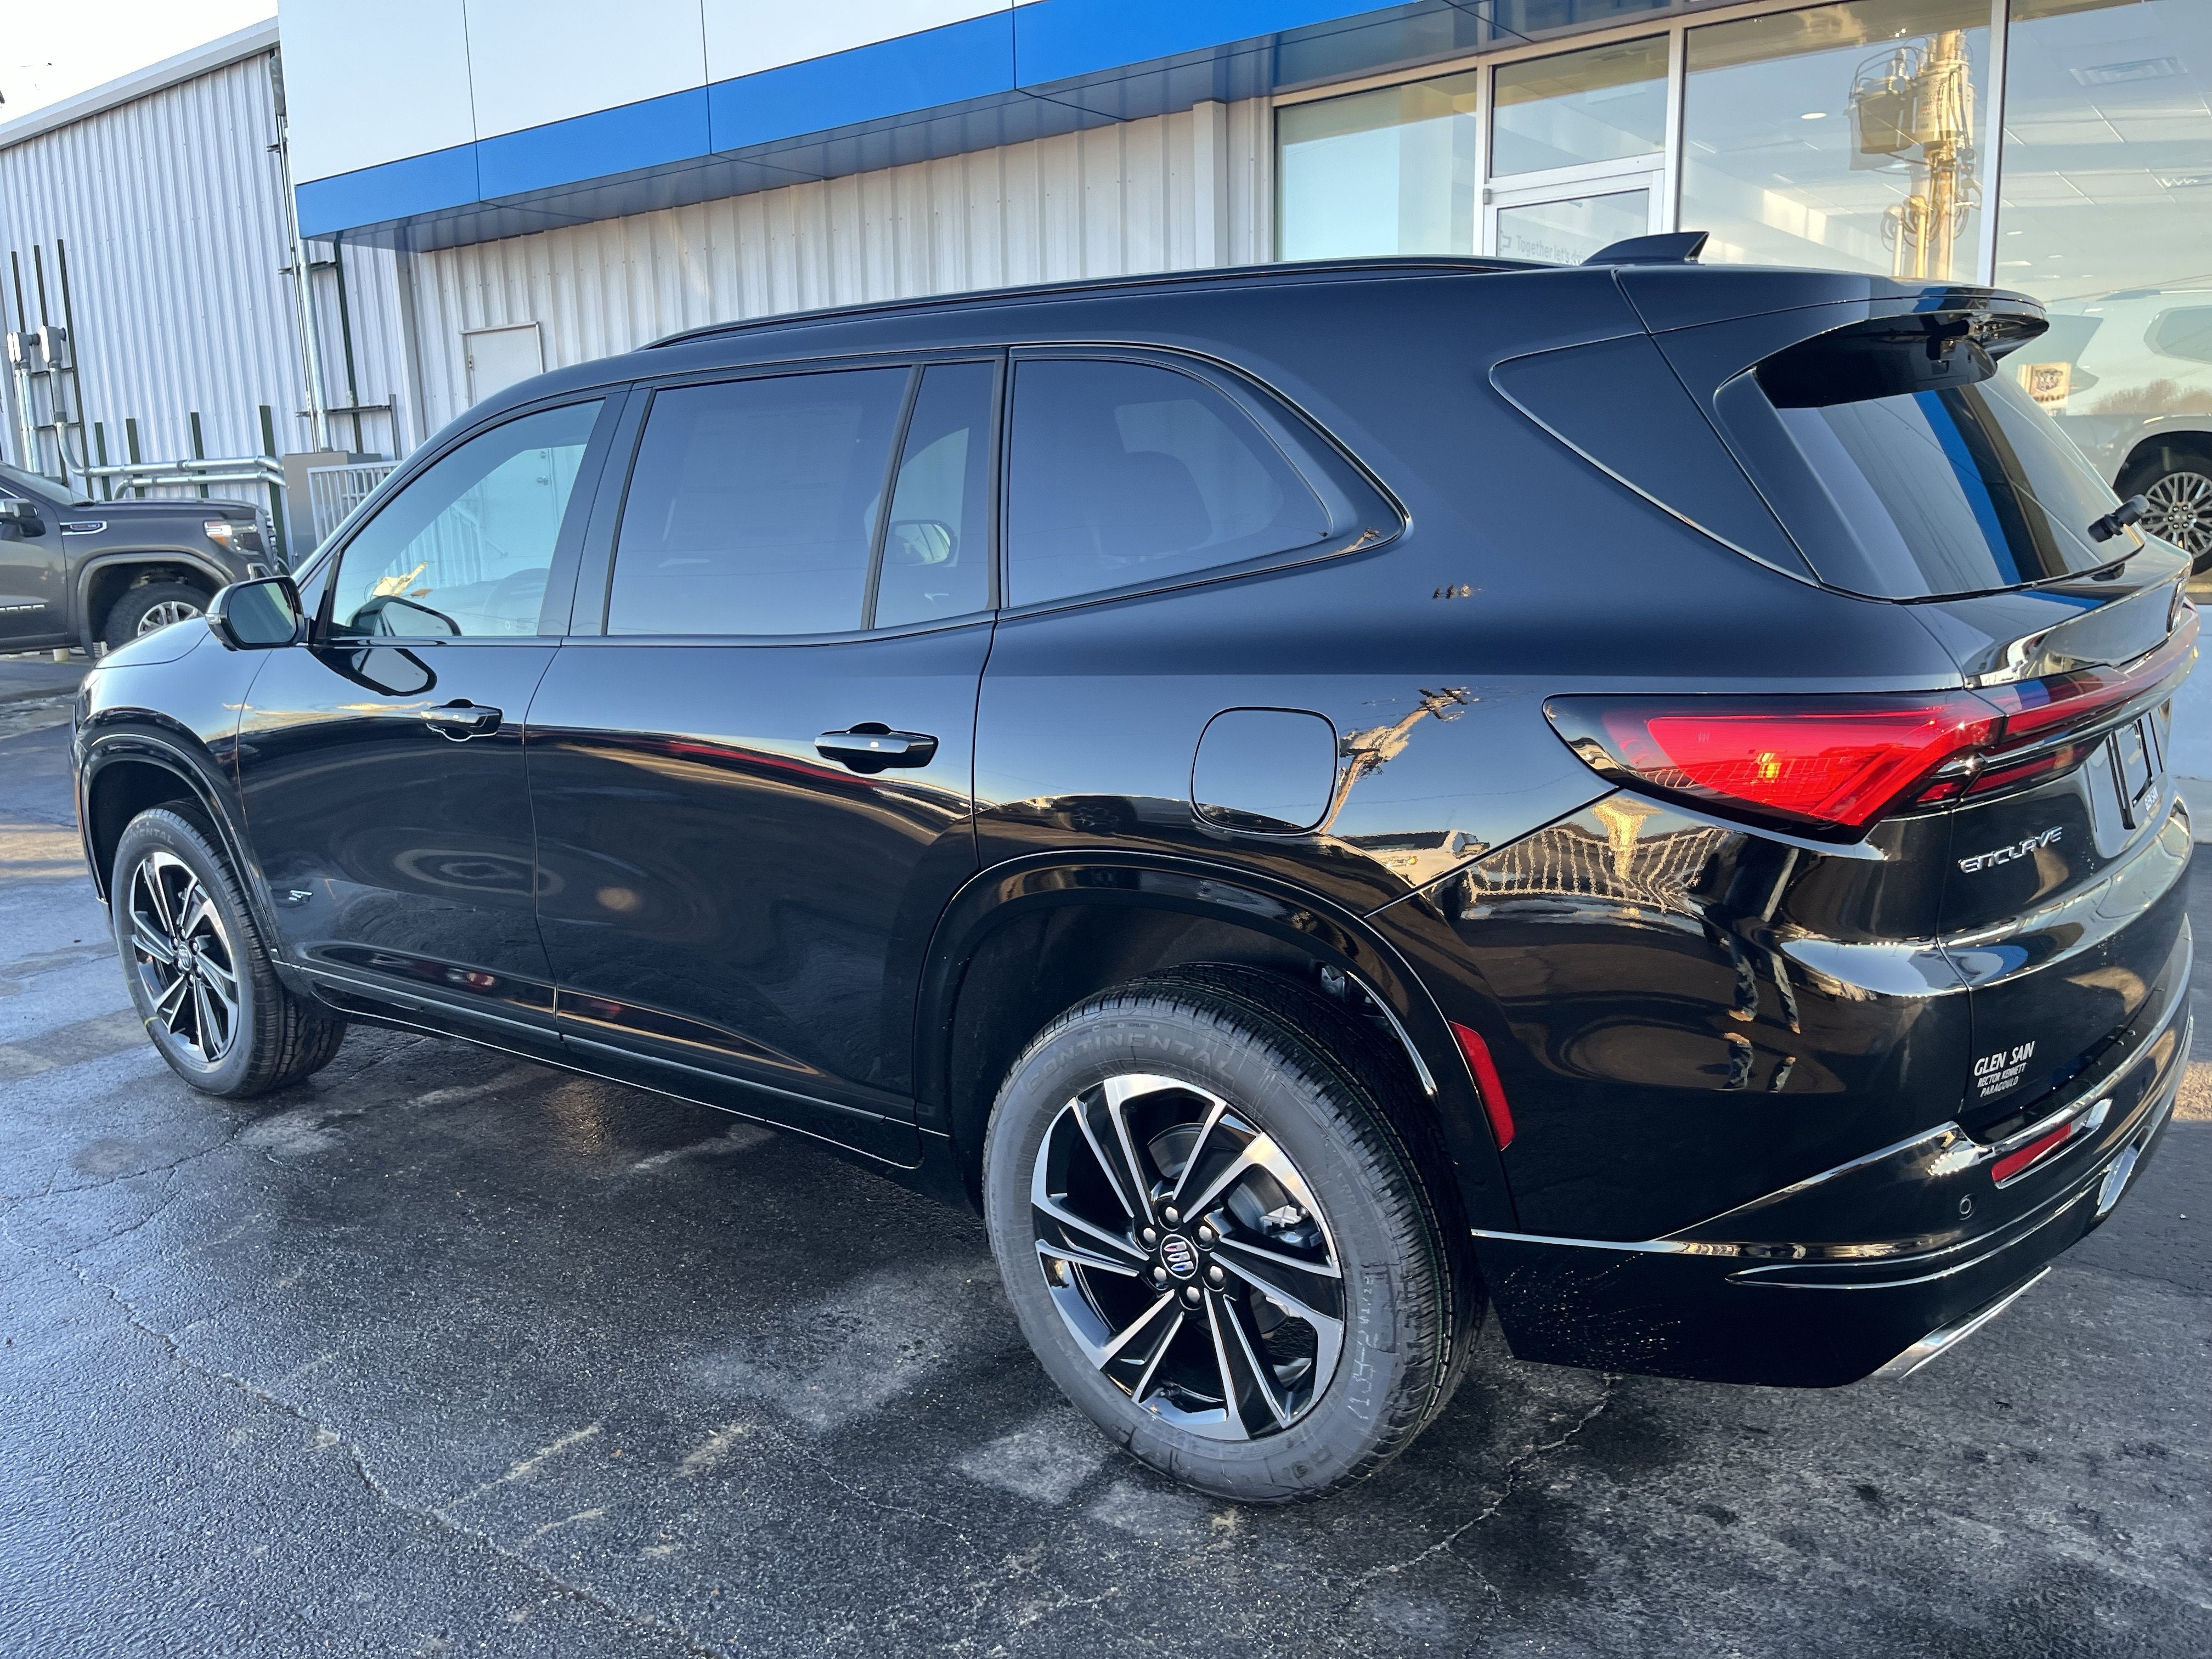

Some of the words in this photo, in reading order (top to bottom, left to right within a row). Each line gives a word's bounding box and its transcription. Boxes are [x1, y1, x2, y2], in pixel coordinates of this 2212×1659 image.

[1516, 235, 1553, 260] Together
[1957, 826, 2063, 873] ENCLAVE
[1027, 1032, 1235, 1095] CONTINENTAL
[1974, 1051, 2007, 1076] GLEN
[2009, 1041, 2035, 1065] SAIN
[1977, 1072, 2001, 1088] RECTOR
